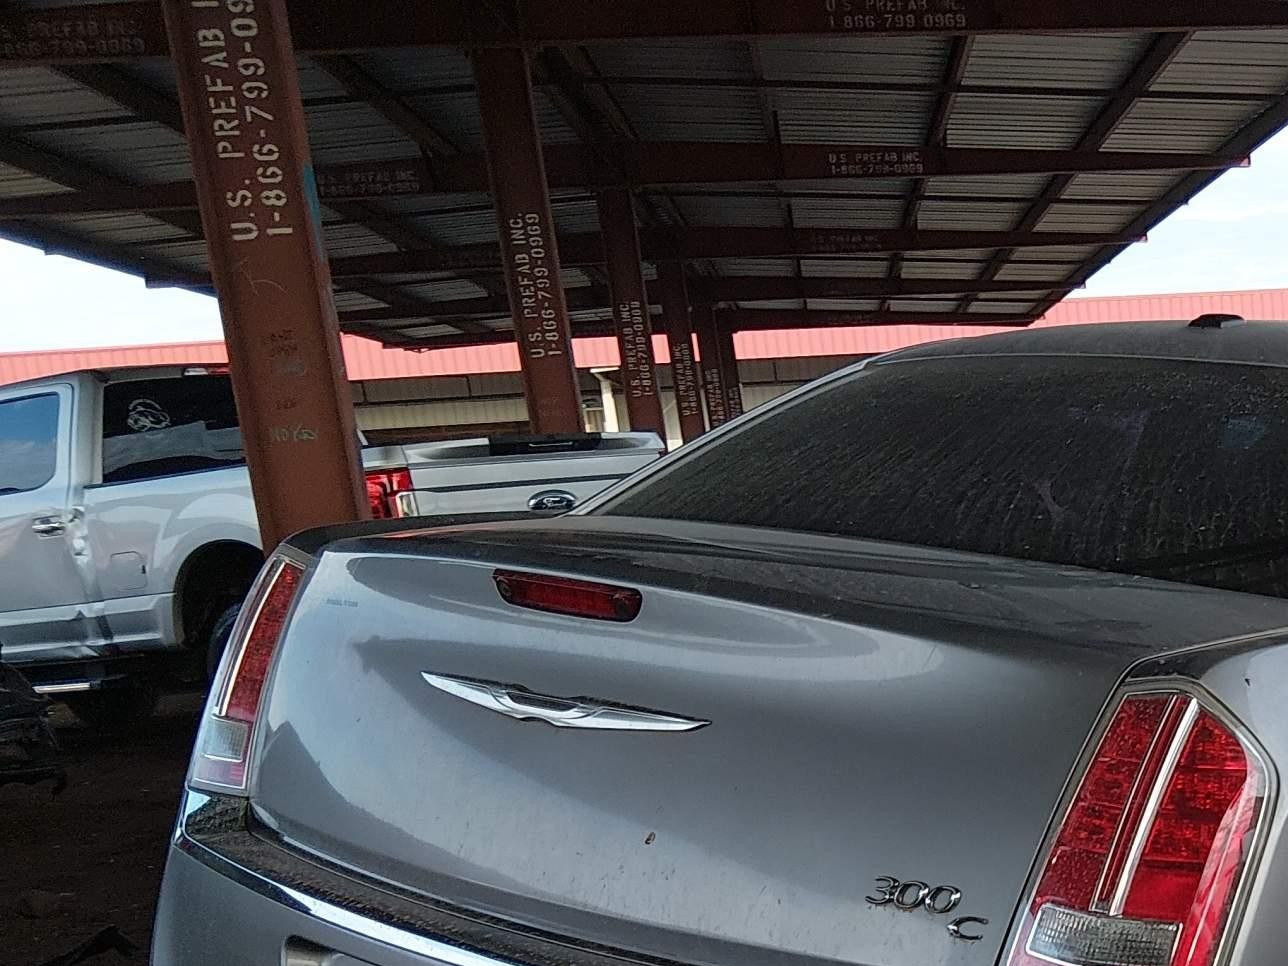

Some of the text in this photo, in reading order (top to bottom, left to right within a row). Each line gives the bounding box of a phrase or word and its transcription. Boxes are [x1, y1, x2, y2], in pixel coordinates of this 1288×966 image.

[197, 25, 246, 158] PREFAB
[225, 179, 259, 240] U.S.
[509, 212, 545, 359] U.S. PREFAB INC.
[864, 875, 990, 941] 300 C
